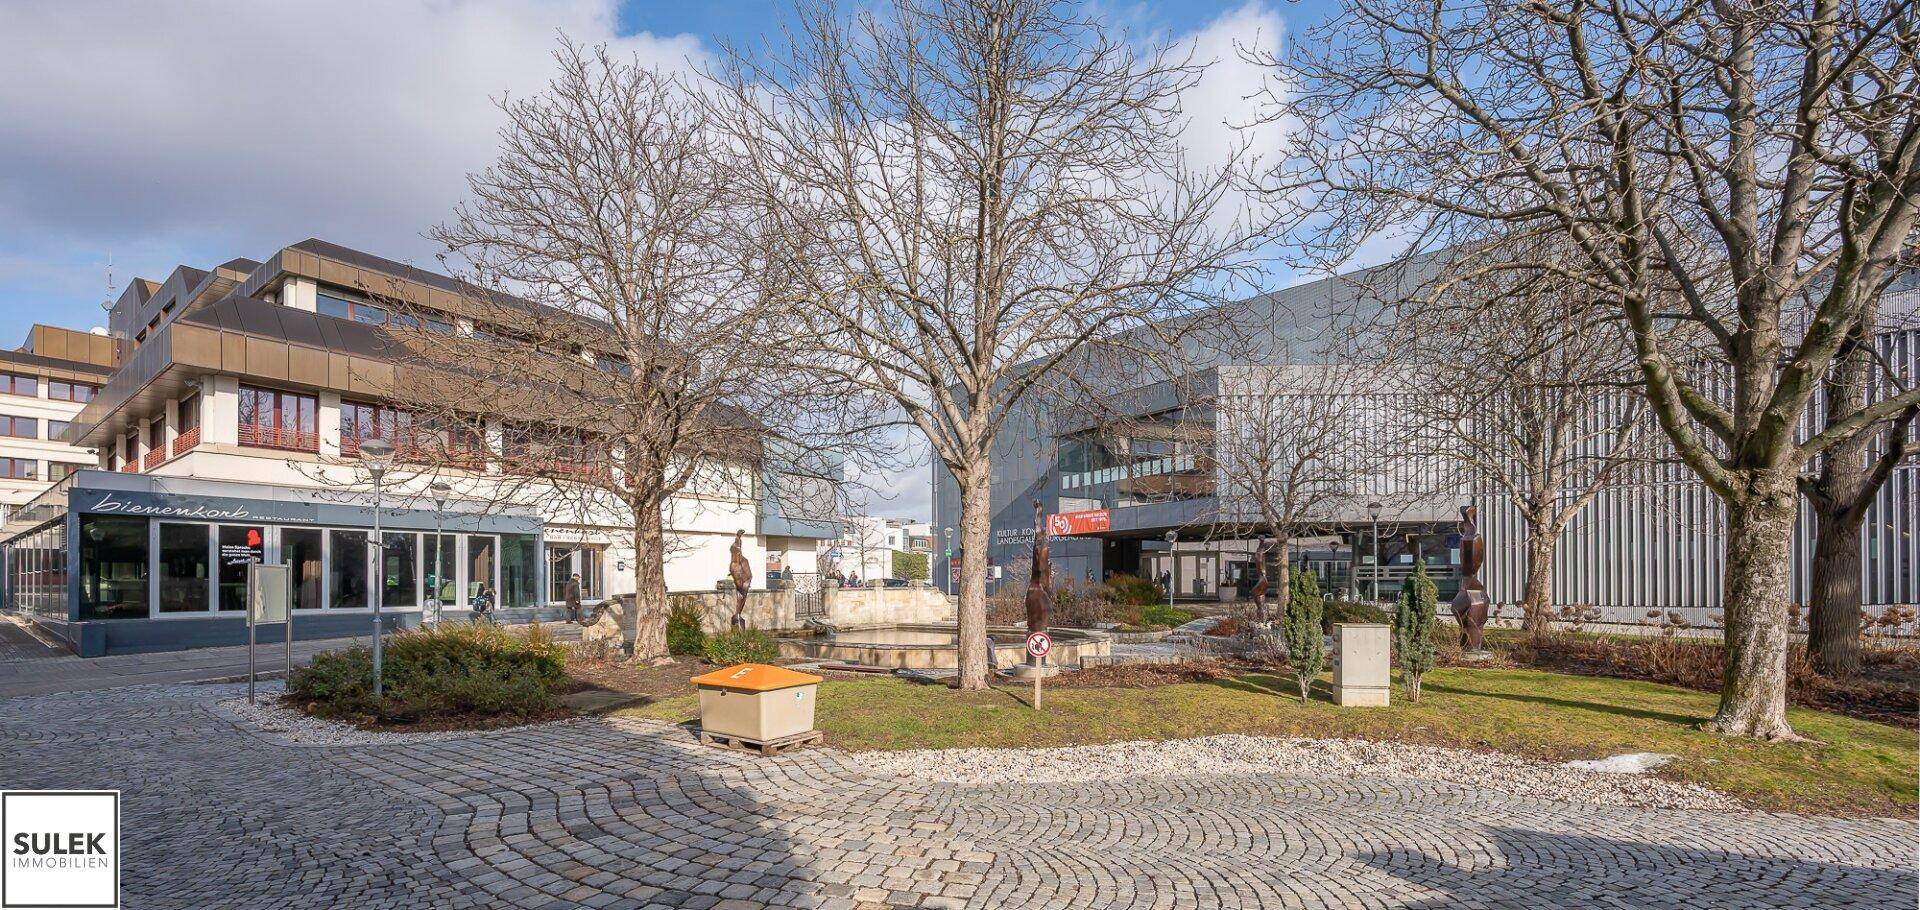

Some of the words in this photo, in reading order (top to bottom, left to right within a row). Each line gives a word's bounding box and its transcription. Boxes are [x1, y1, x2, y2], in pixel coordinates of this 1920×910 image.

[91, 493, 249, 519] bienenkorb
[997, 528, 1018, 537] KULTUR
[730, 667, 753, 680] E
